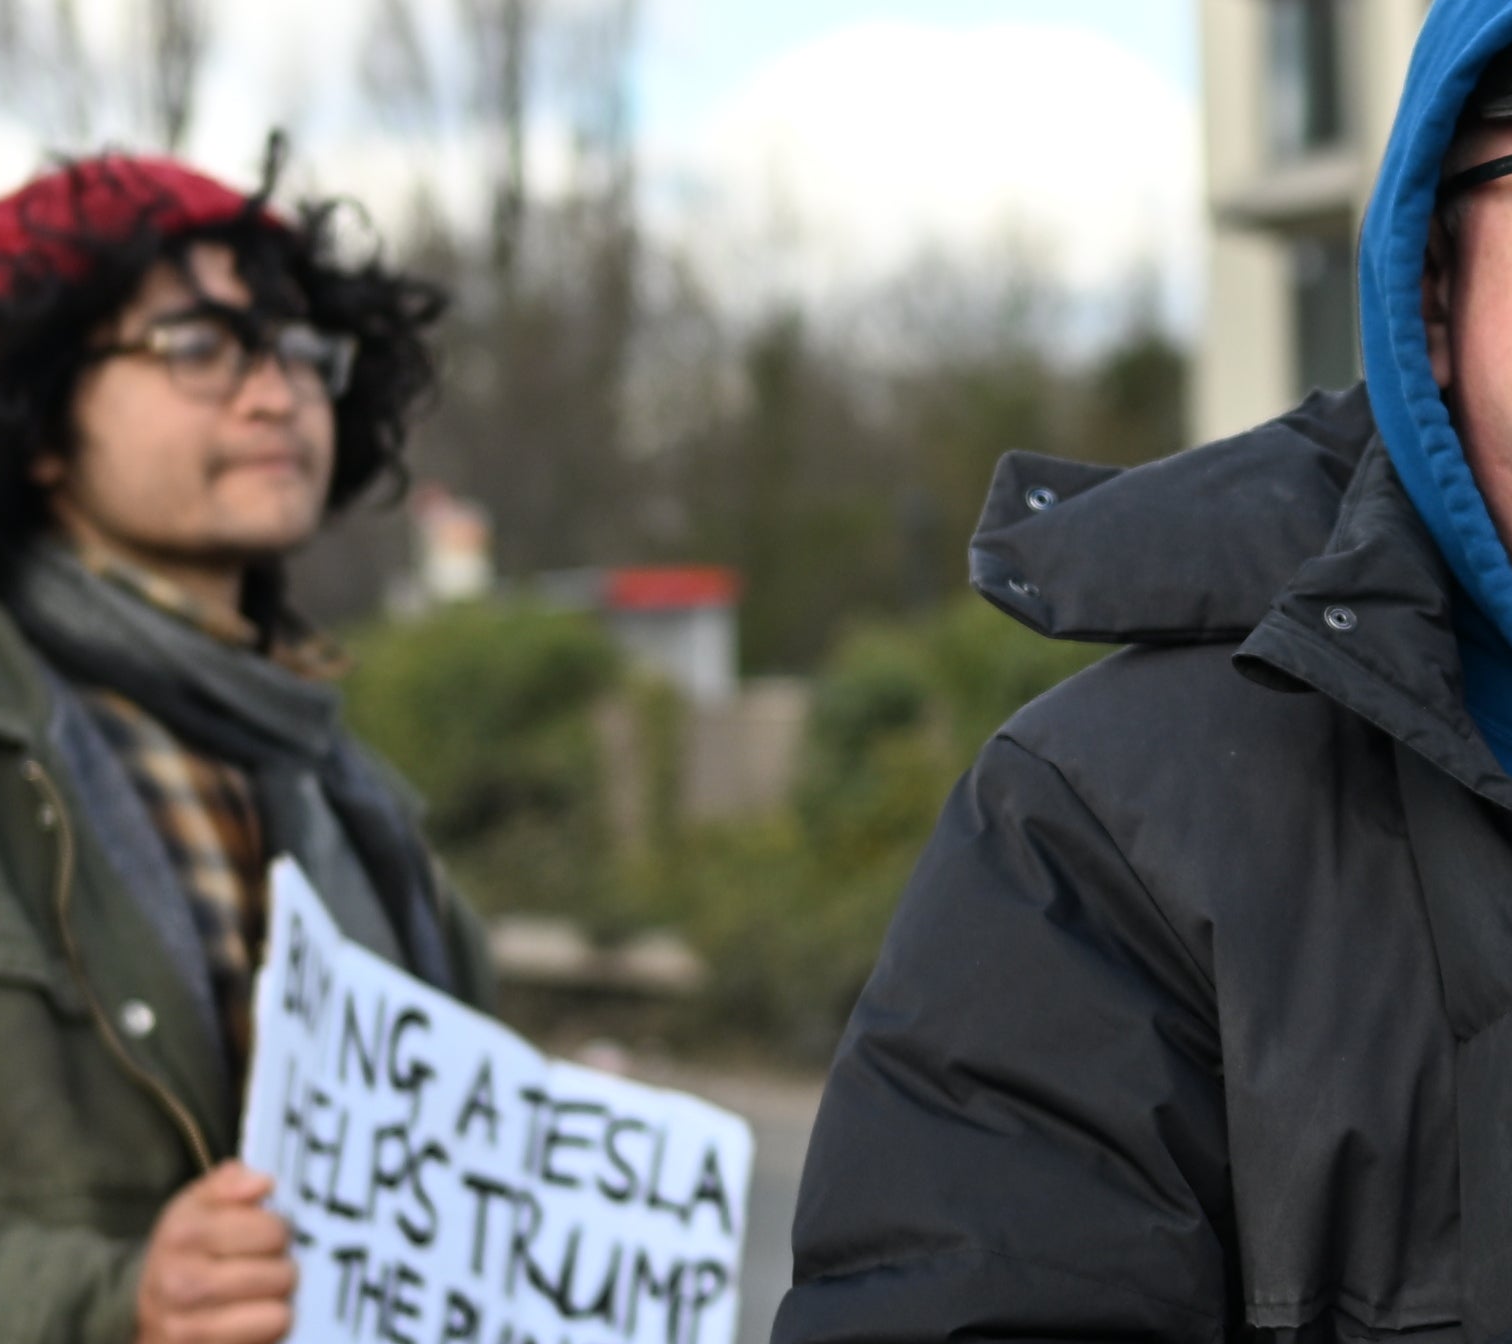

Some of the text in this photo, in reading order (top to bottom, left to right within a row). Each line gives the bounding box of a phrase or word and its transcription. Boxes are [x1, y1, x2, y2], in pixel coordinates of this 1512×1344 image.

[283, 1059, 449, 1248] HELPS
[456, 1056, 500, 1146] A
[519, 1086, 733, 1236] TESLA
